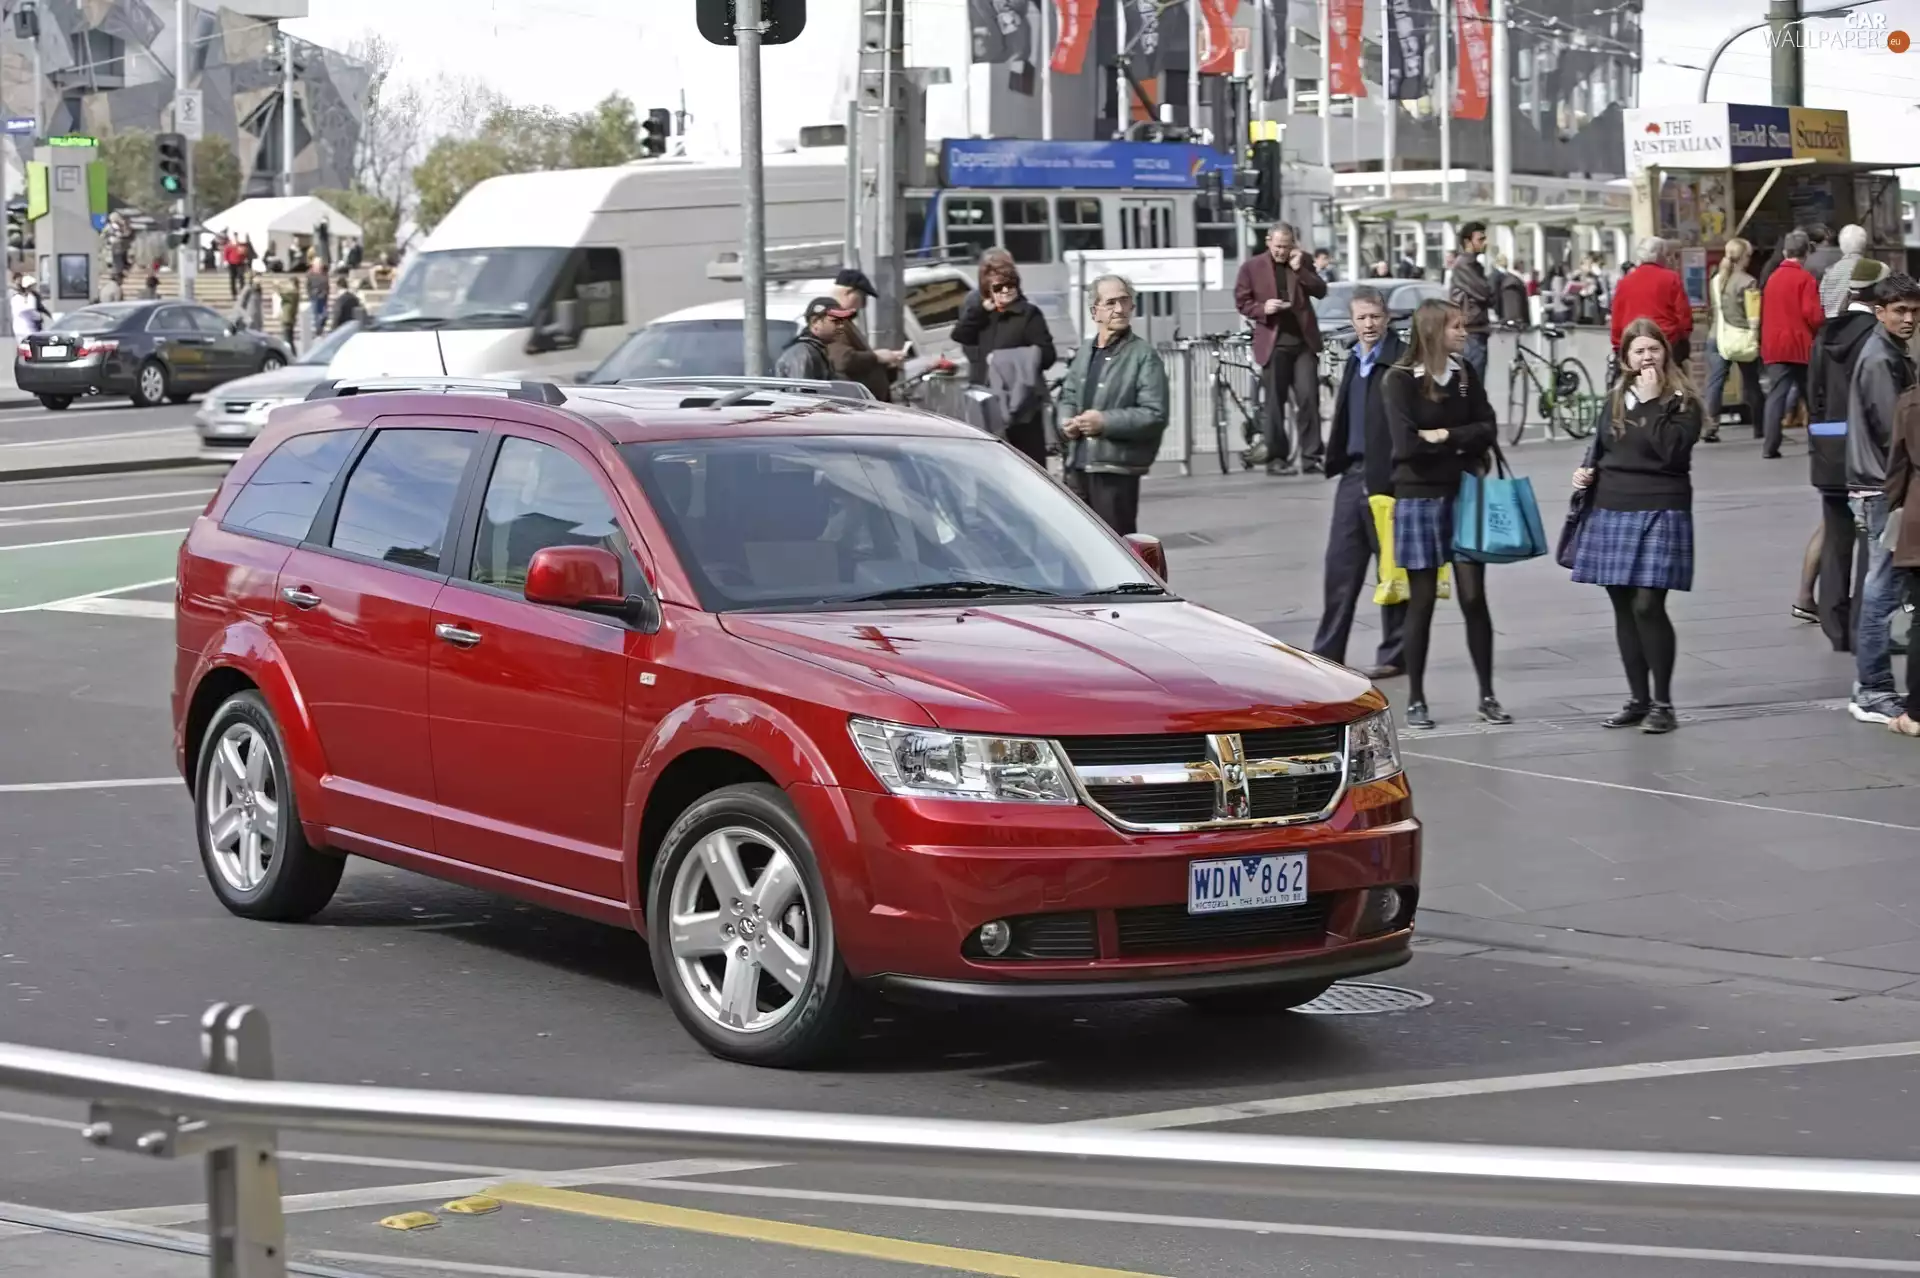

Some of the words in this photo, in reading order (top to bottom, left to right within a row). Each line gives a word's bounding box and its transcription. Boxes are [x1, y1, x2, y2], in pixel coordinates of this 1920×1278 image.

[1664, 120, 1692, 135] THE
[1730, 123, 1767, 147] Herald
[1796, 120, 1845, 156] Sunday
[1633, 136, 1723, 153] AUSTRALIAN
[1194, 866, 1241, 899] WDN
[1261, 861, 1303, 893] 862
